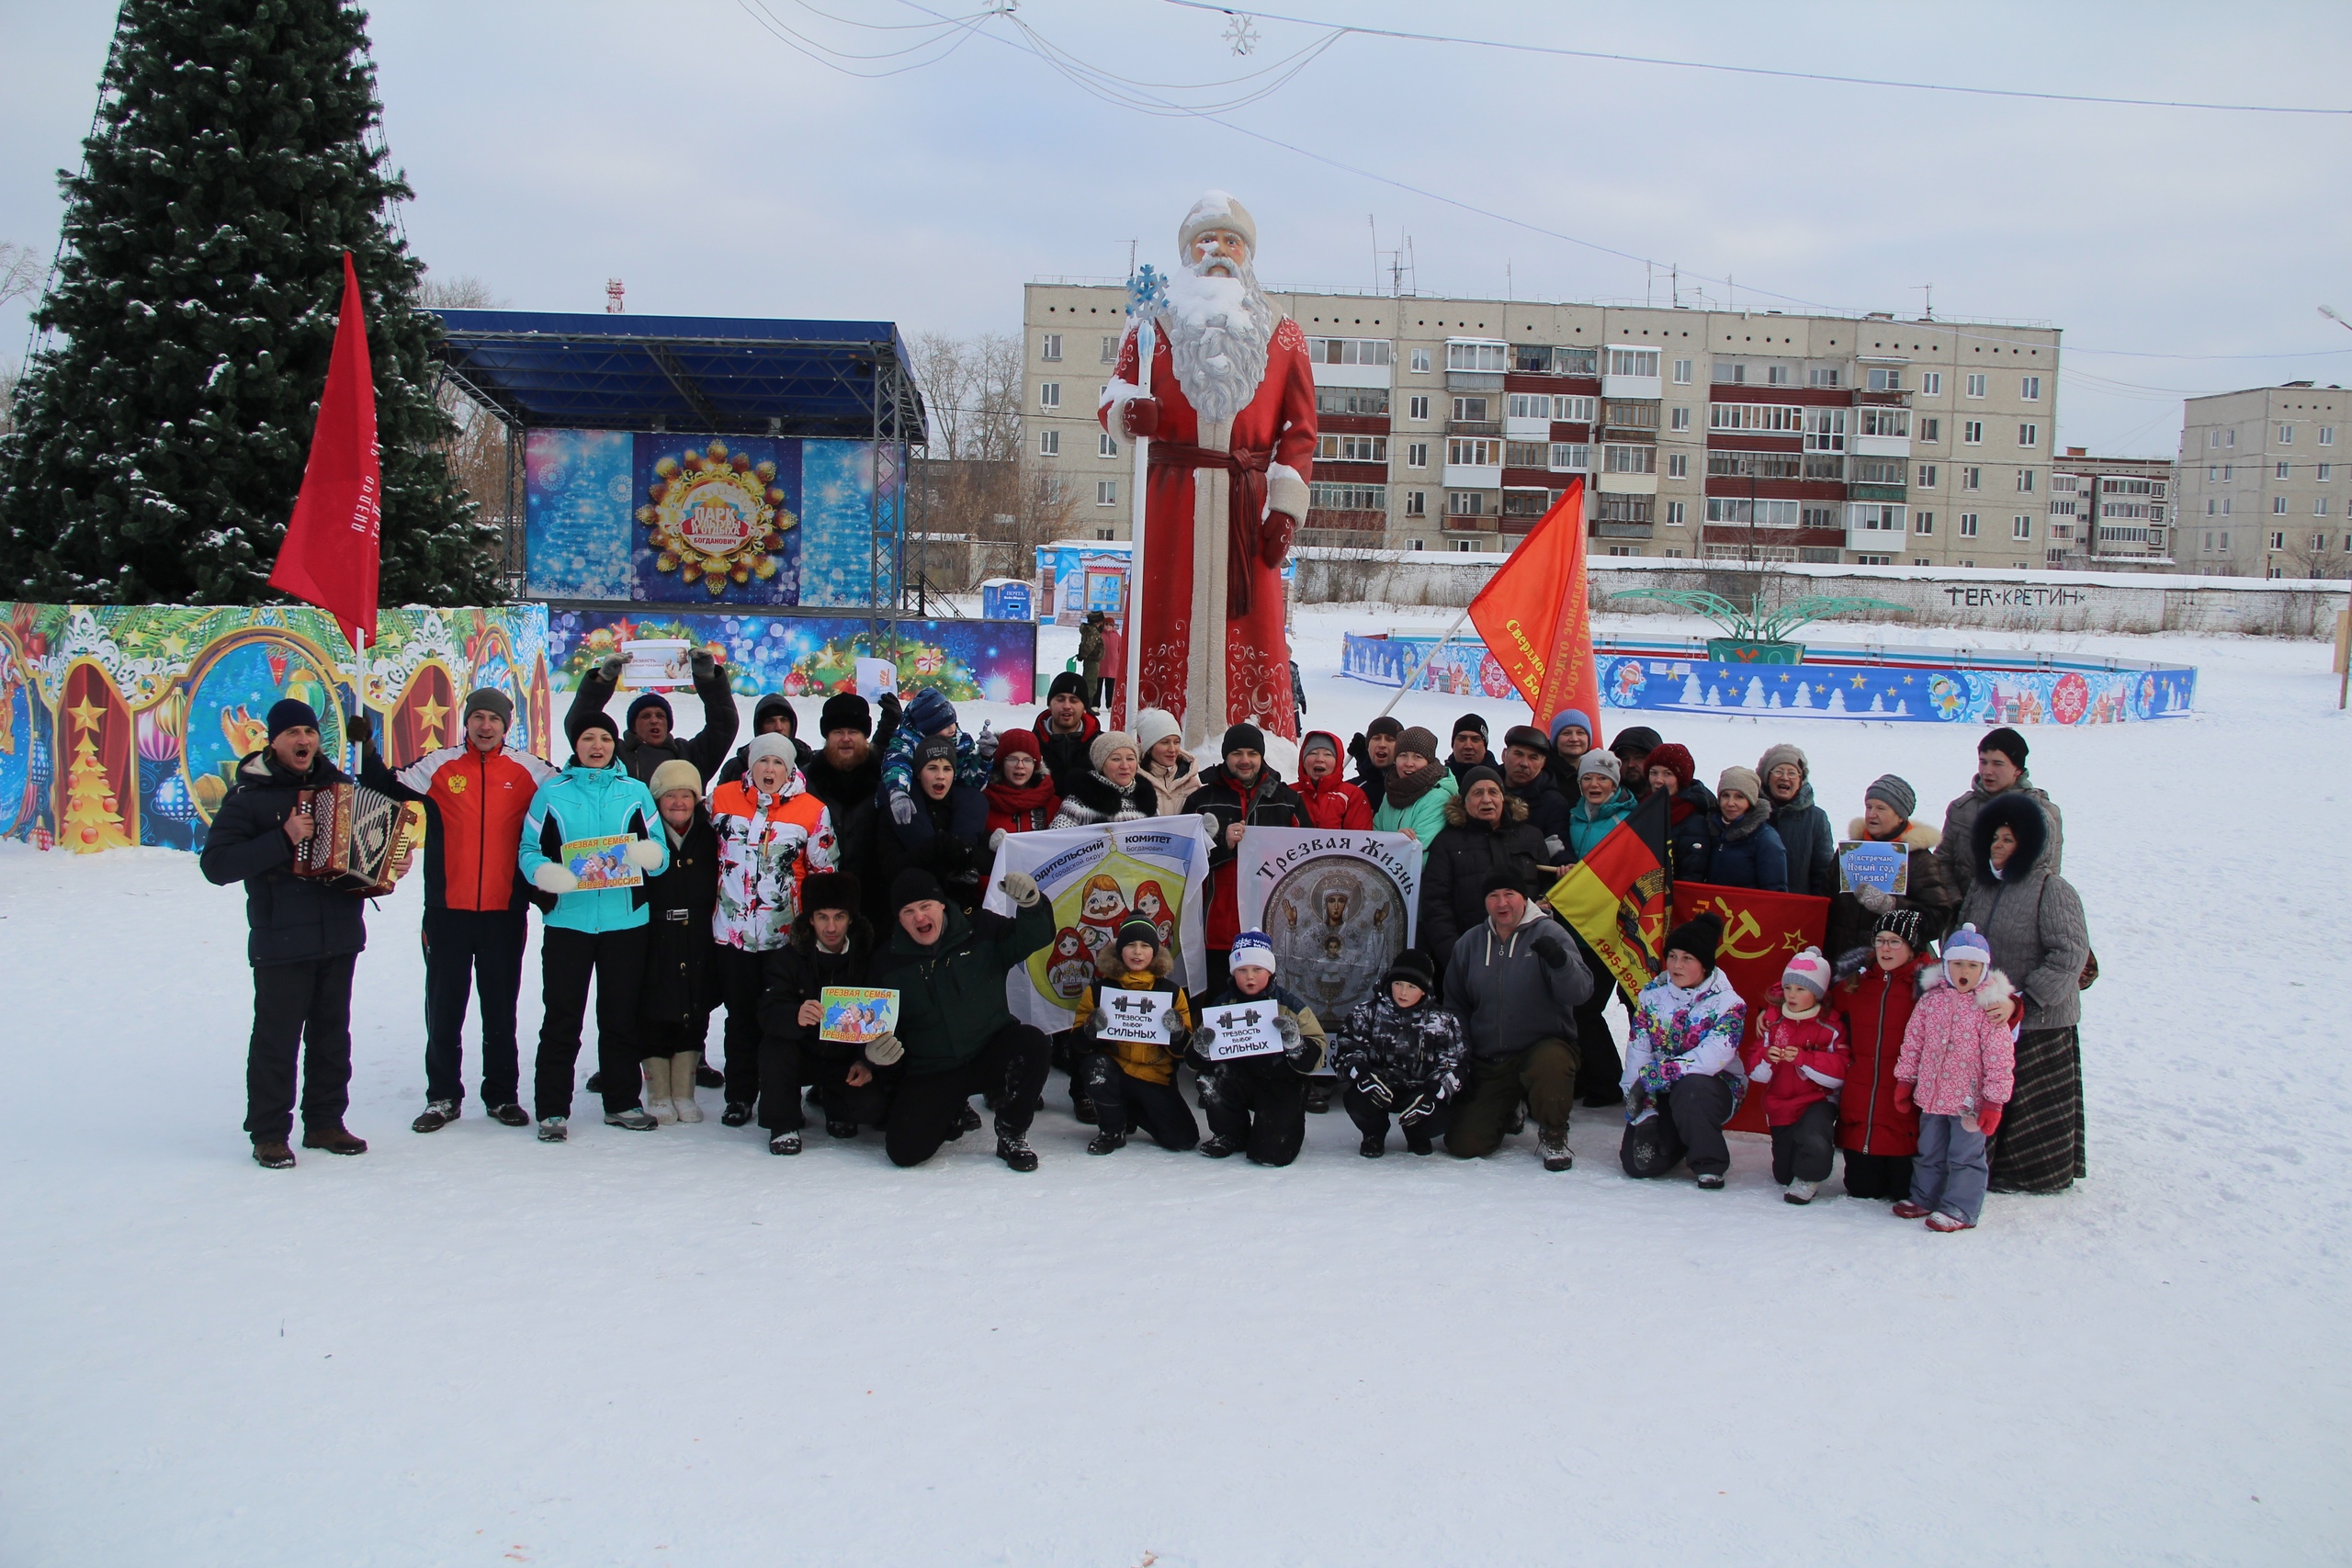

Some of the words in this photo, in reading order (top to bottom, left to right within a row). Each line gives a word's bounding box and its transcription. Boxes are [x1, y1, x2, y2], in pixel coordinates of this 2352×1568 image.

[695, 507, 736, 521] ПАРК
[691, 519, 741, 528] КУЛЬТУРЫ
[701, 526, 741, 535] ОТДЫХА
[564, 840, 598, 851] ТРЕЗВАЯ
[602, 836, 629, 846] СЕМЬЯ
[1034, 839, 1104, 883] одительский
[1051, 858, 1084, 880] Городской
[1086, 852, 1104, 863] округ
[1256, 837, 1351, 881] Трезвая
[1359, 837, 1414, 896] Жизнь
[1848, 863, 1875, 871] Новый
[1879, 865, 1894, 874] год
[577, 880, 604, 889] ЕЗВАЯ
[607, 876, 641, 886] РОССИЯ!
[1853, 873, 1888, 882] Трезво!
[1595, 938, 1643, 997] 1945-1994
[825, 988, 860, 997] ТРЕЗВАЯ
[864, 990, 891, 998] СЕМЬЯ
[1114, 1013, 1153, 1022] ТРЕЗВОСТЬ
[821, 1030, 856, 1040] ТРЕЗВАЯ
[1107, 1027, 1157, 1039] СИЛЬНЫХ
[1222, 1028, 1261, 1038] ТРЕЗВОСТЬ
[1218, 1041, 1269, 1055] СИЛЬНЫХ
